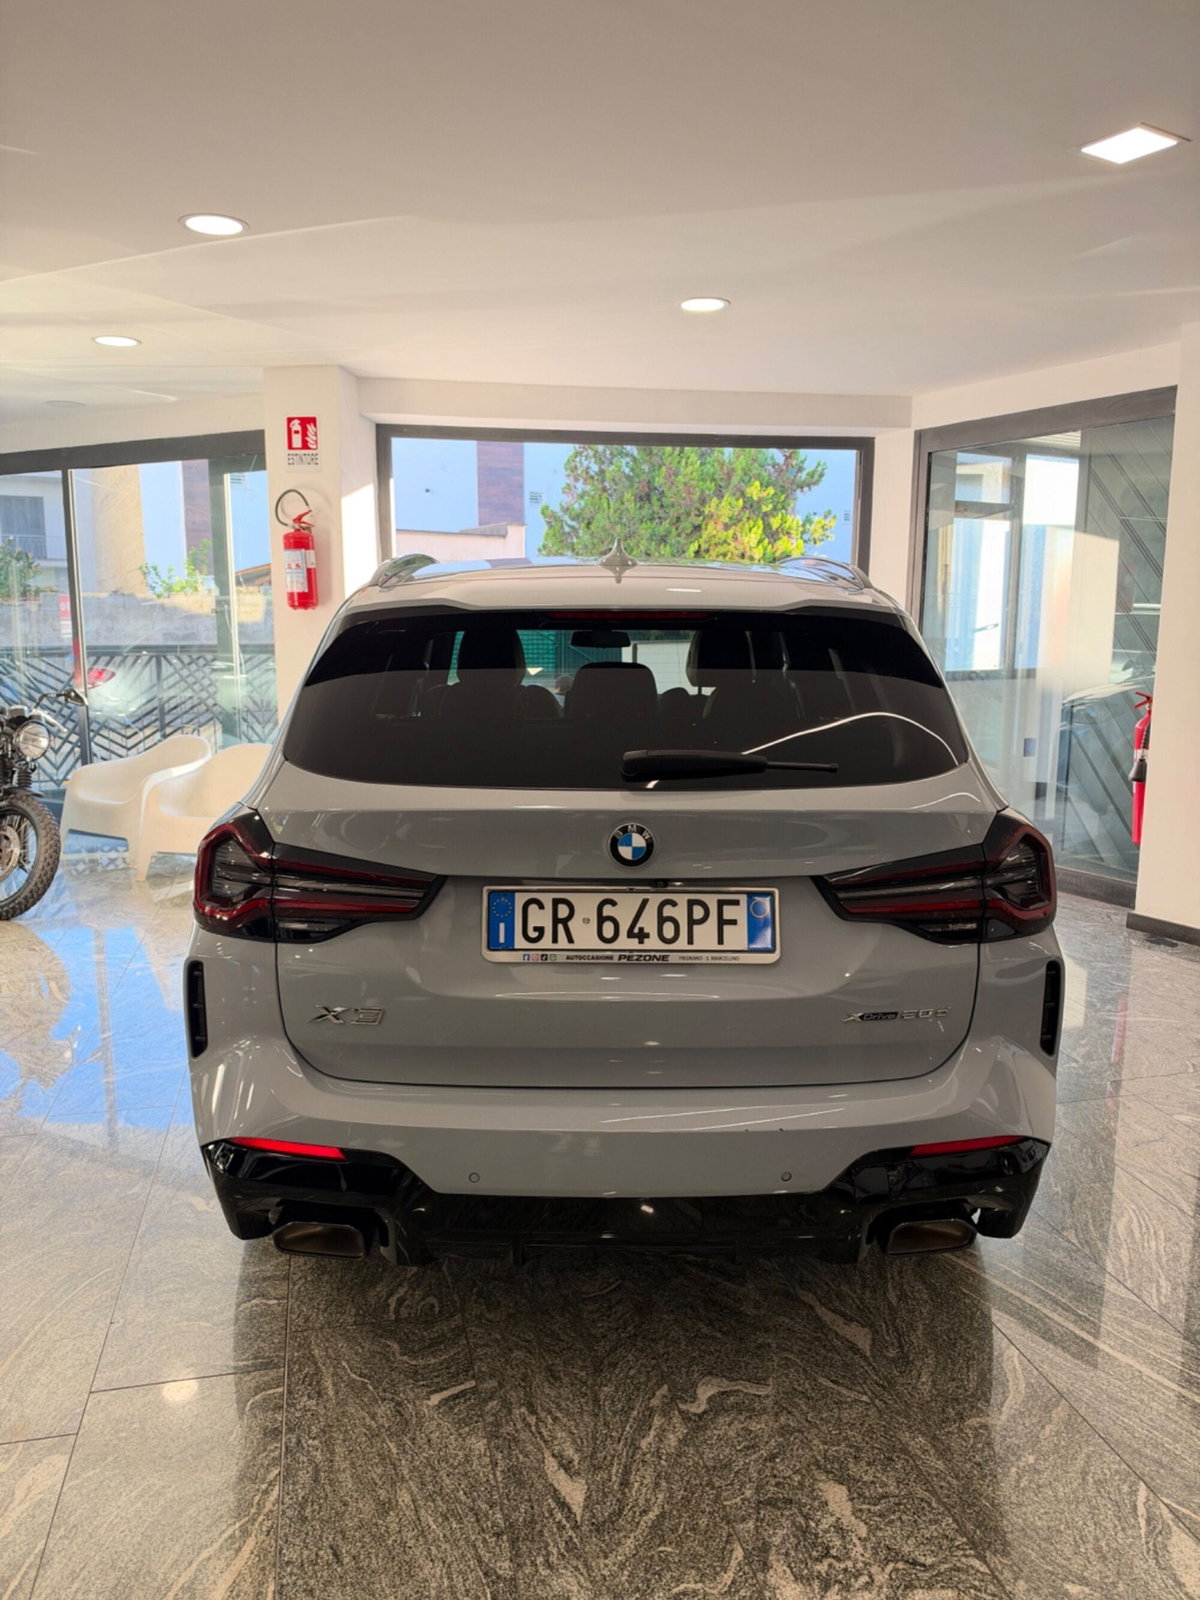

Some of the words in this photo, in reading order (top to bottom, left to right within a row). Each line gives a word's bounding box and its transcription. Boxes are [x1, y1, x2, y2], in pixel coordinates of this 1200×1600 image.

[287, 453, 319, 466] ESTINTORE
[613, 824, 652, 840] BMW
[521, 898, 575, 944] GR
[596, 898, 741, 945] 646PF
[617, 954, 670, 962] PEZONE
[308, 1005, 384, 1025] X3
